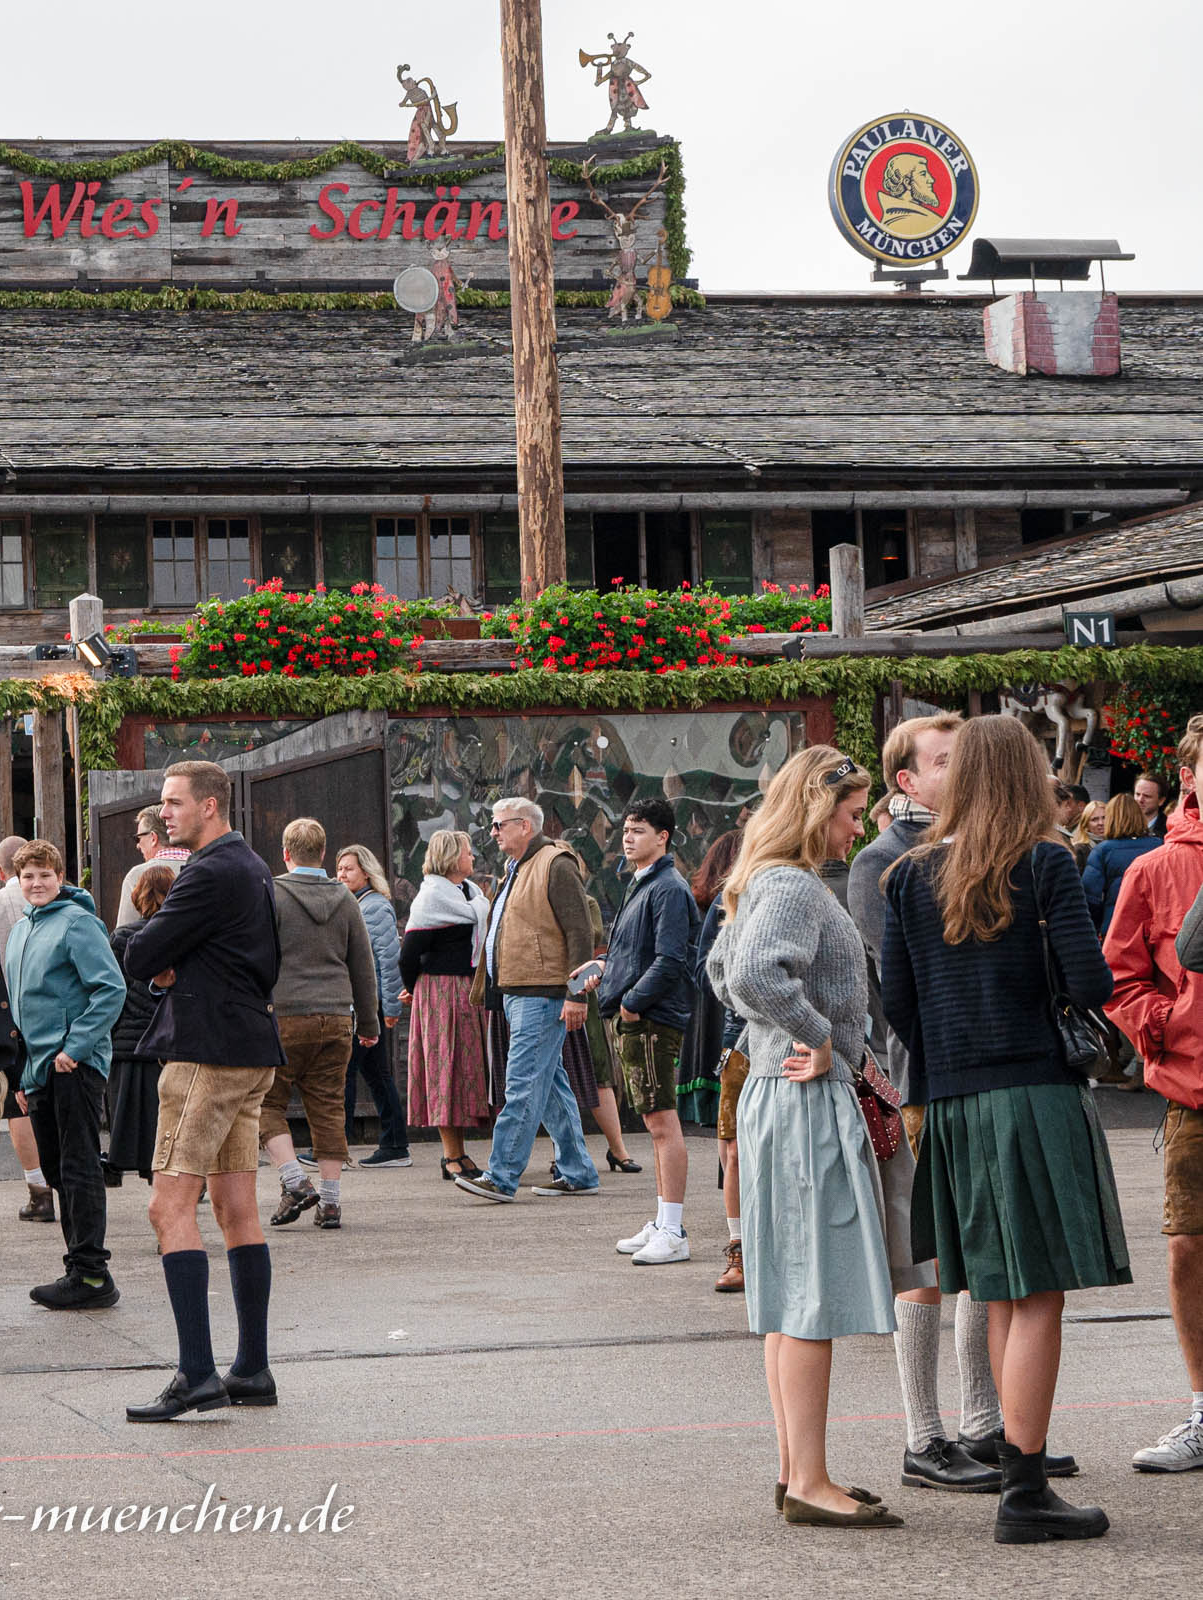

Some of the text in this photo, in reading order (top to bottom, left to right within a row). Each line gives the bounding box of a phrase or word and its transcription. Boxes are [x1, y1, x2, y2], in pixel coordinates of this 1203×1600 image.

[842, 119, 969, 180] PAULANER
[309, 182, 580, 241] Schäne
[855, 216, 966, 258] MÜNCHEN
[1072, 617, 1111, 644] N1
